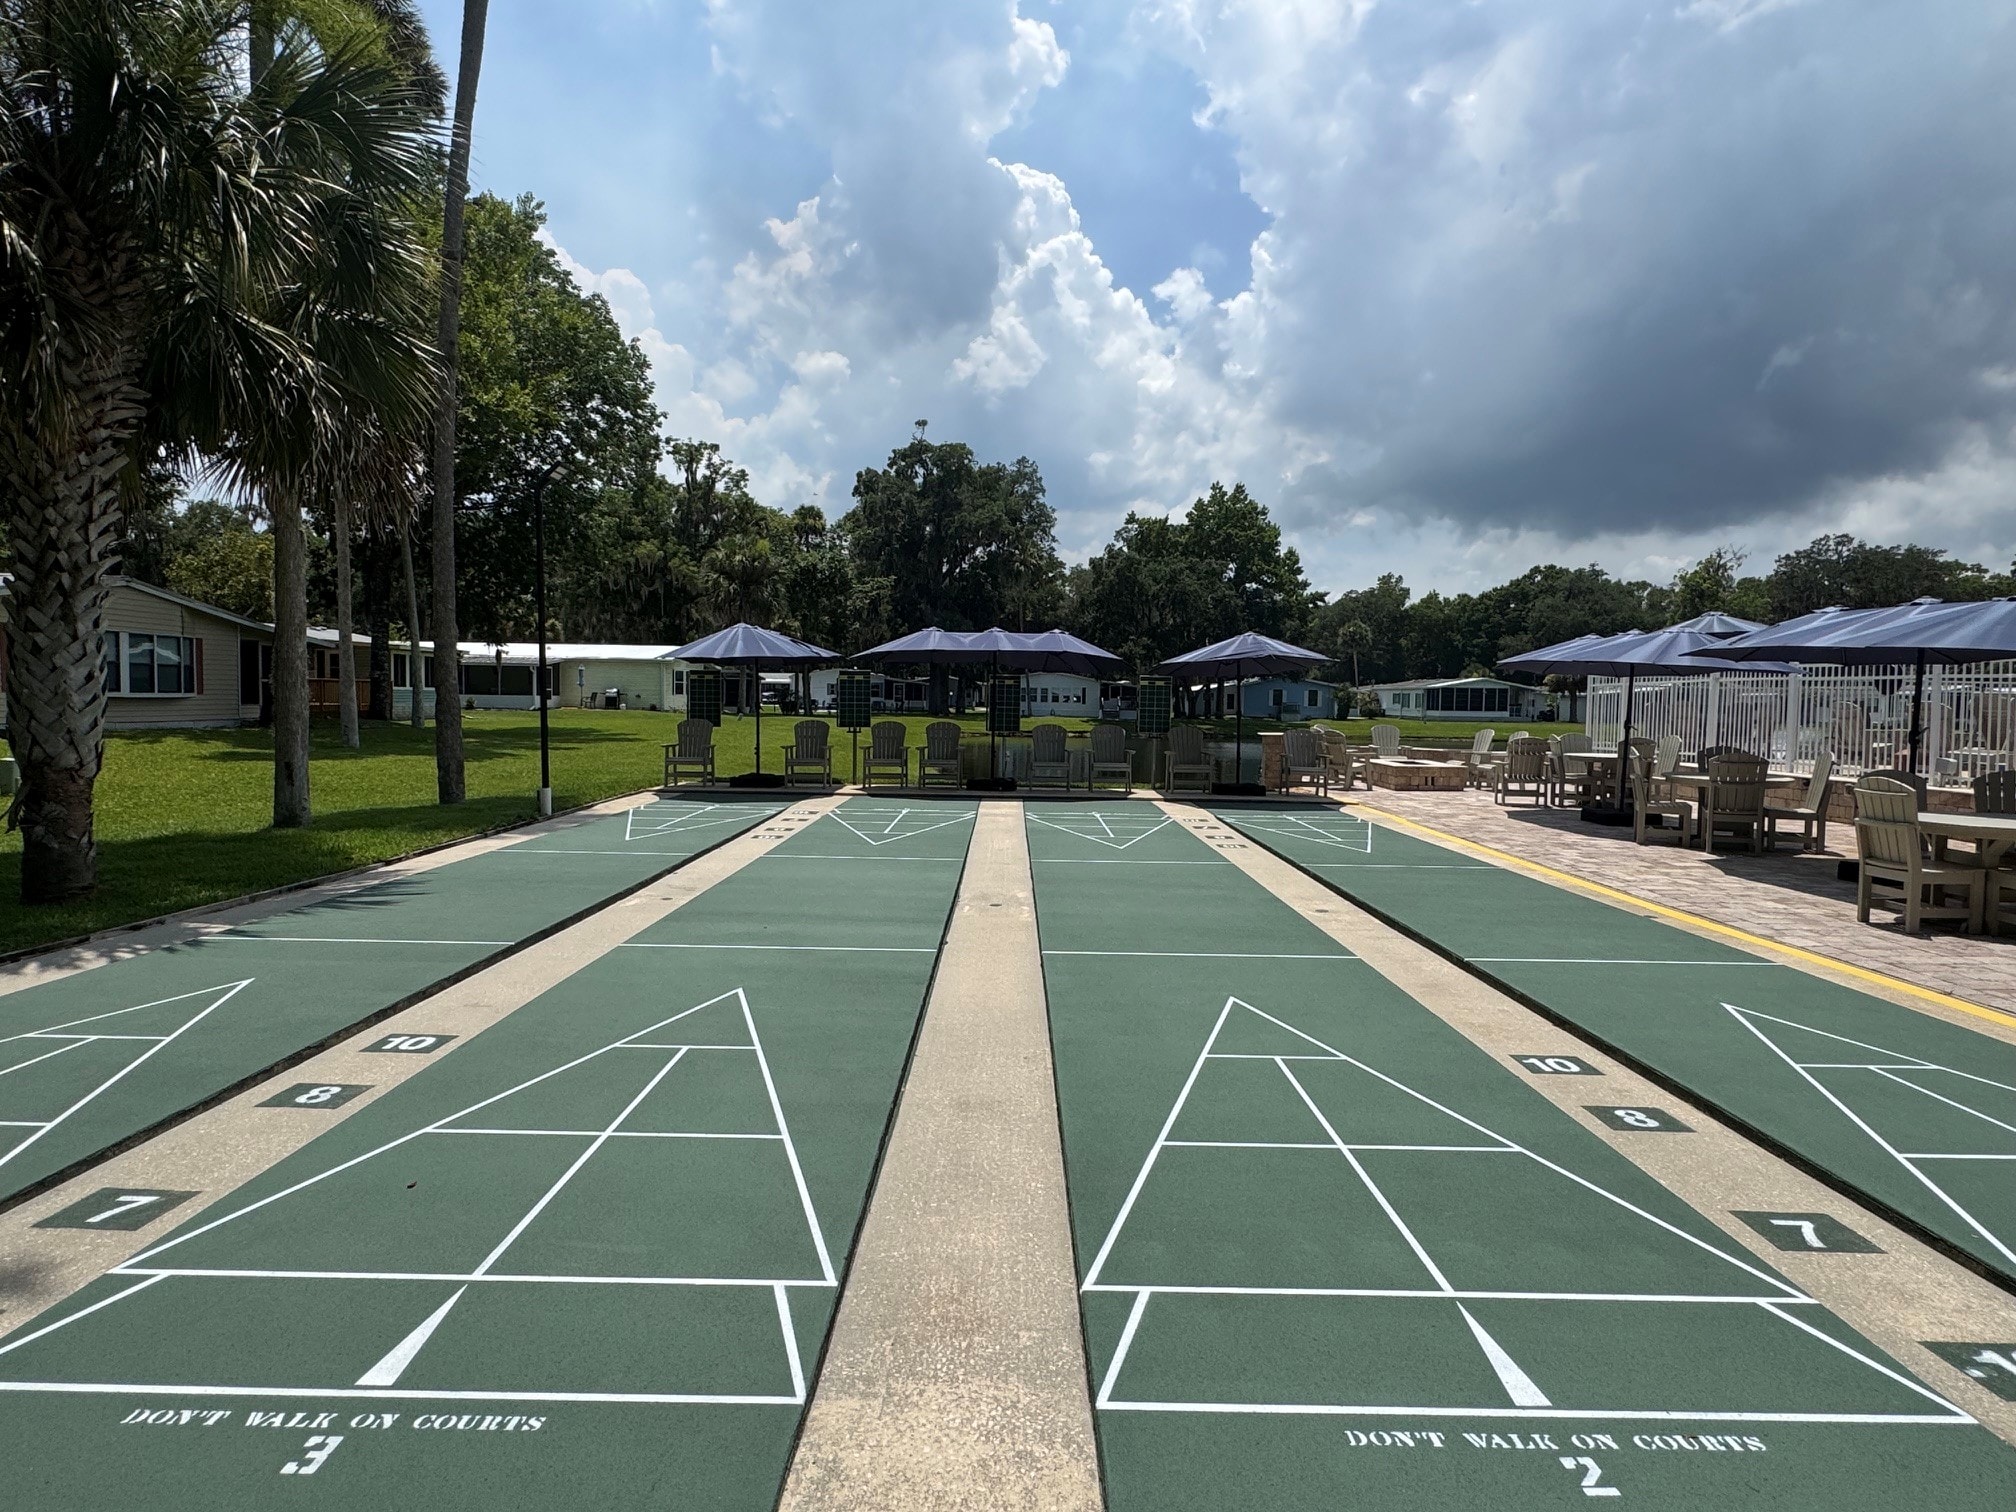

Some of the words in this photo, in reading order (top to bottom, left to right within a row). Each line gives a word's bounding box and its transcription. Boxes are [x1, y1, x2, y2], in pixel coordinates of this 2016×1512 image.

[381, 1036, 436, 1050] 10
[1522, 1058, 1581, 1072] 10
[295, 1086, 342, 1104] 8
[1614, 1109, 1660, 1128] 8
[84, 1195, 161, 1223] 7
[1769, 1219, 1827, 1248] 7
[119, 1408, 232, 1426] DON'T
[244, 1411, 339, 1429] WALK
[349, 1413, 401, 1430] ON
[412, 1414, 547, 1432] COURTS
[1343, 1430, 1446, 1448] DON'T
[1461, 1432, 1560, 1450] WALK
[1570, 1433, 1620, 1450] ON
[1632, 1434, 1767, 1452] COURTS
[279, 1435, 345, 1475] 3
[1558, 1456, 1622, 1497] 2
